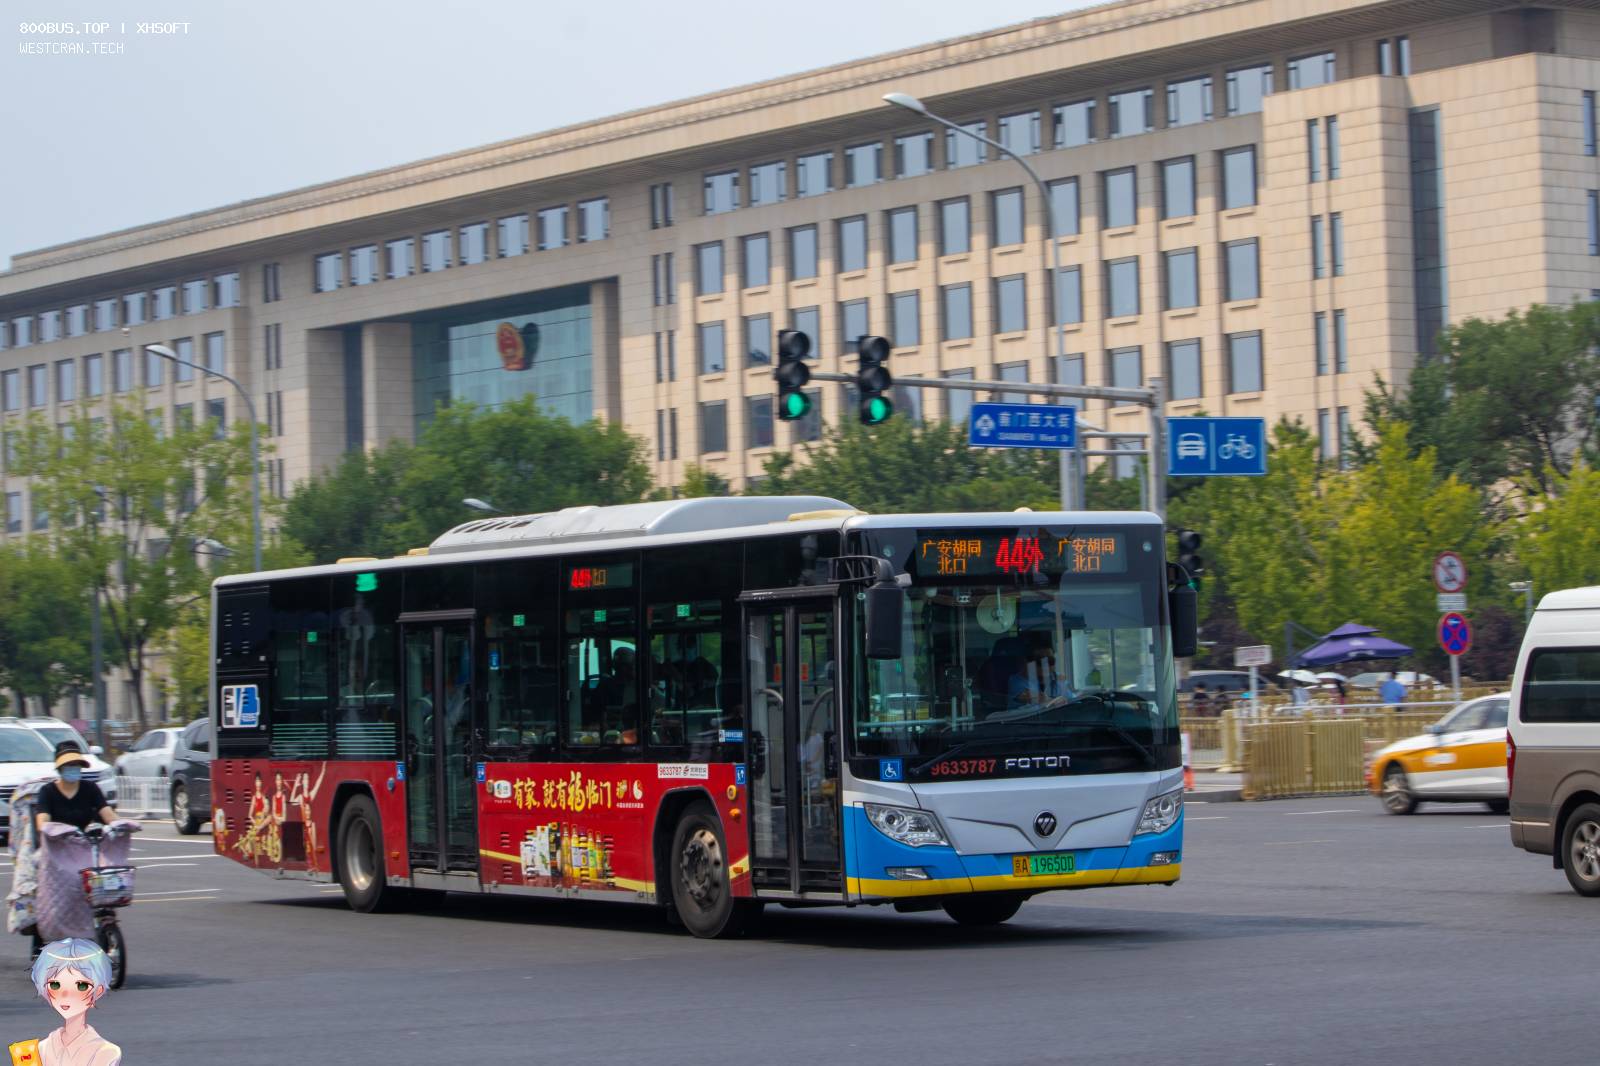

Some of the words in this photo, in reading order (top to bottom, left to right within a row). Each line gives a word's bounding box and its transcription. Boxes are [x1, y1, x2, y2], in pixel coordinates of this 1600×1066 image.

[922, 540, 982, 558] 广安胡同
[995, 537, 1044, 573] 44外
[1058, 537, 1115, 556] 广安胡同
[937, 557, 967, 574] 北口
[1073, 556, 1101, 573] 北口
[1005, 756, 1071, 770] FOTON
